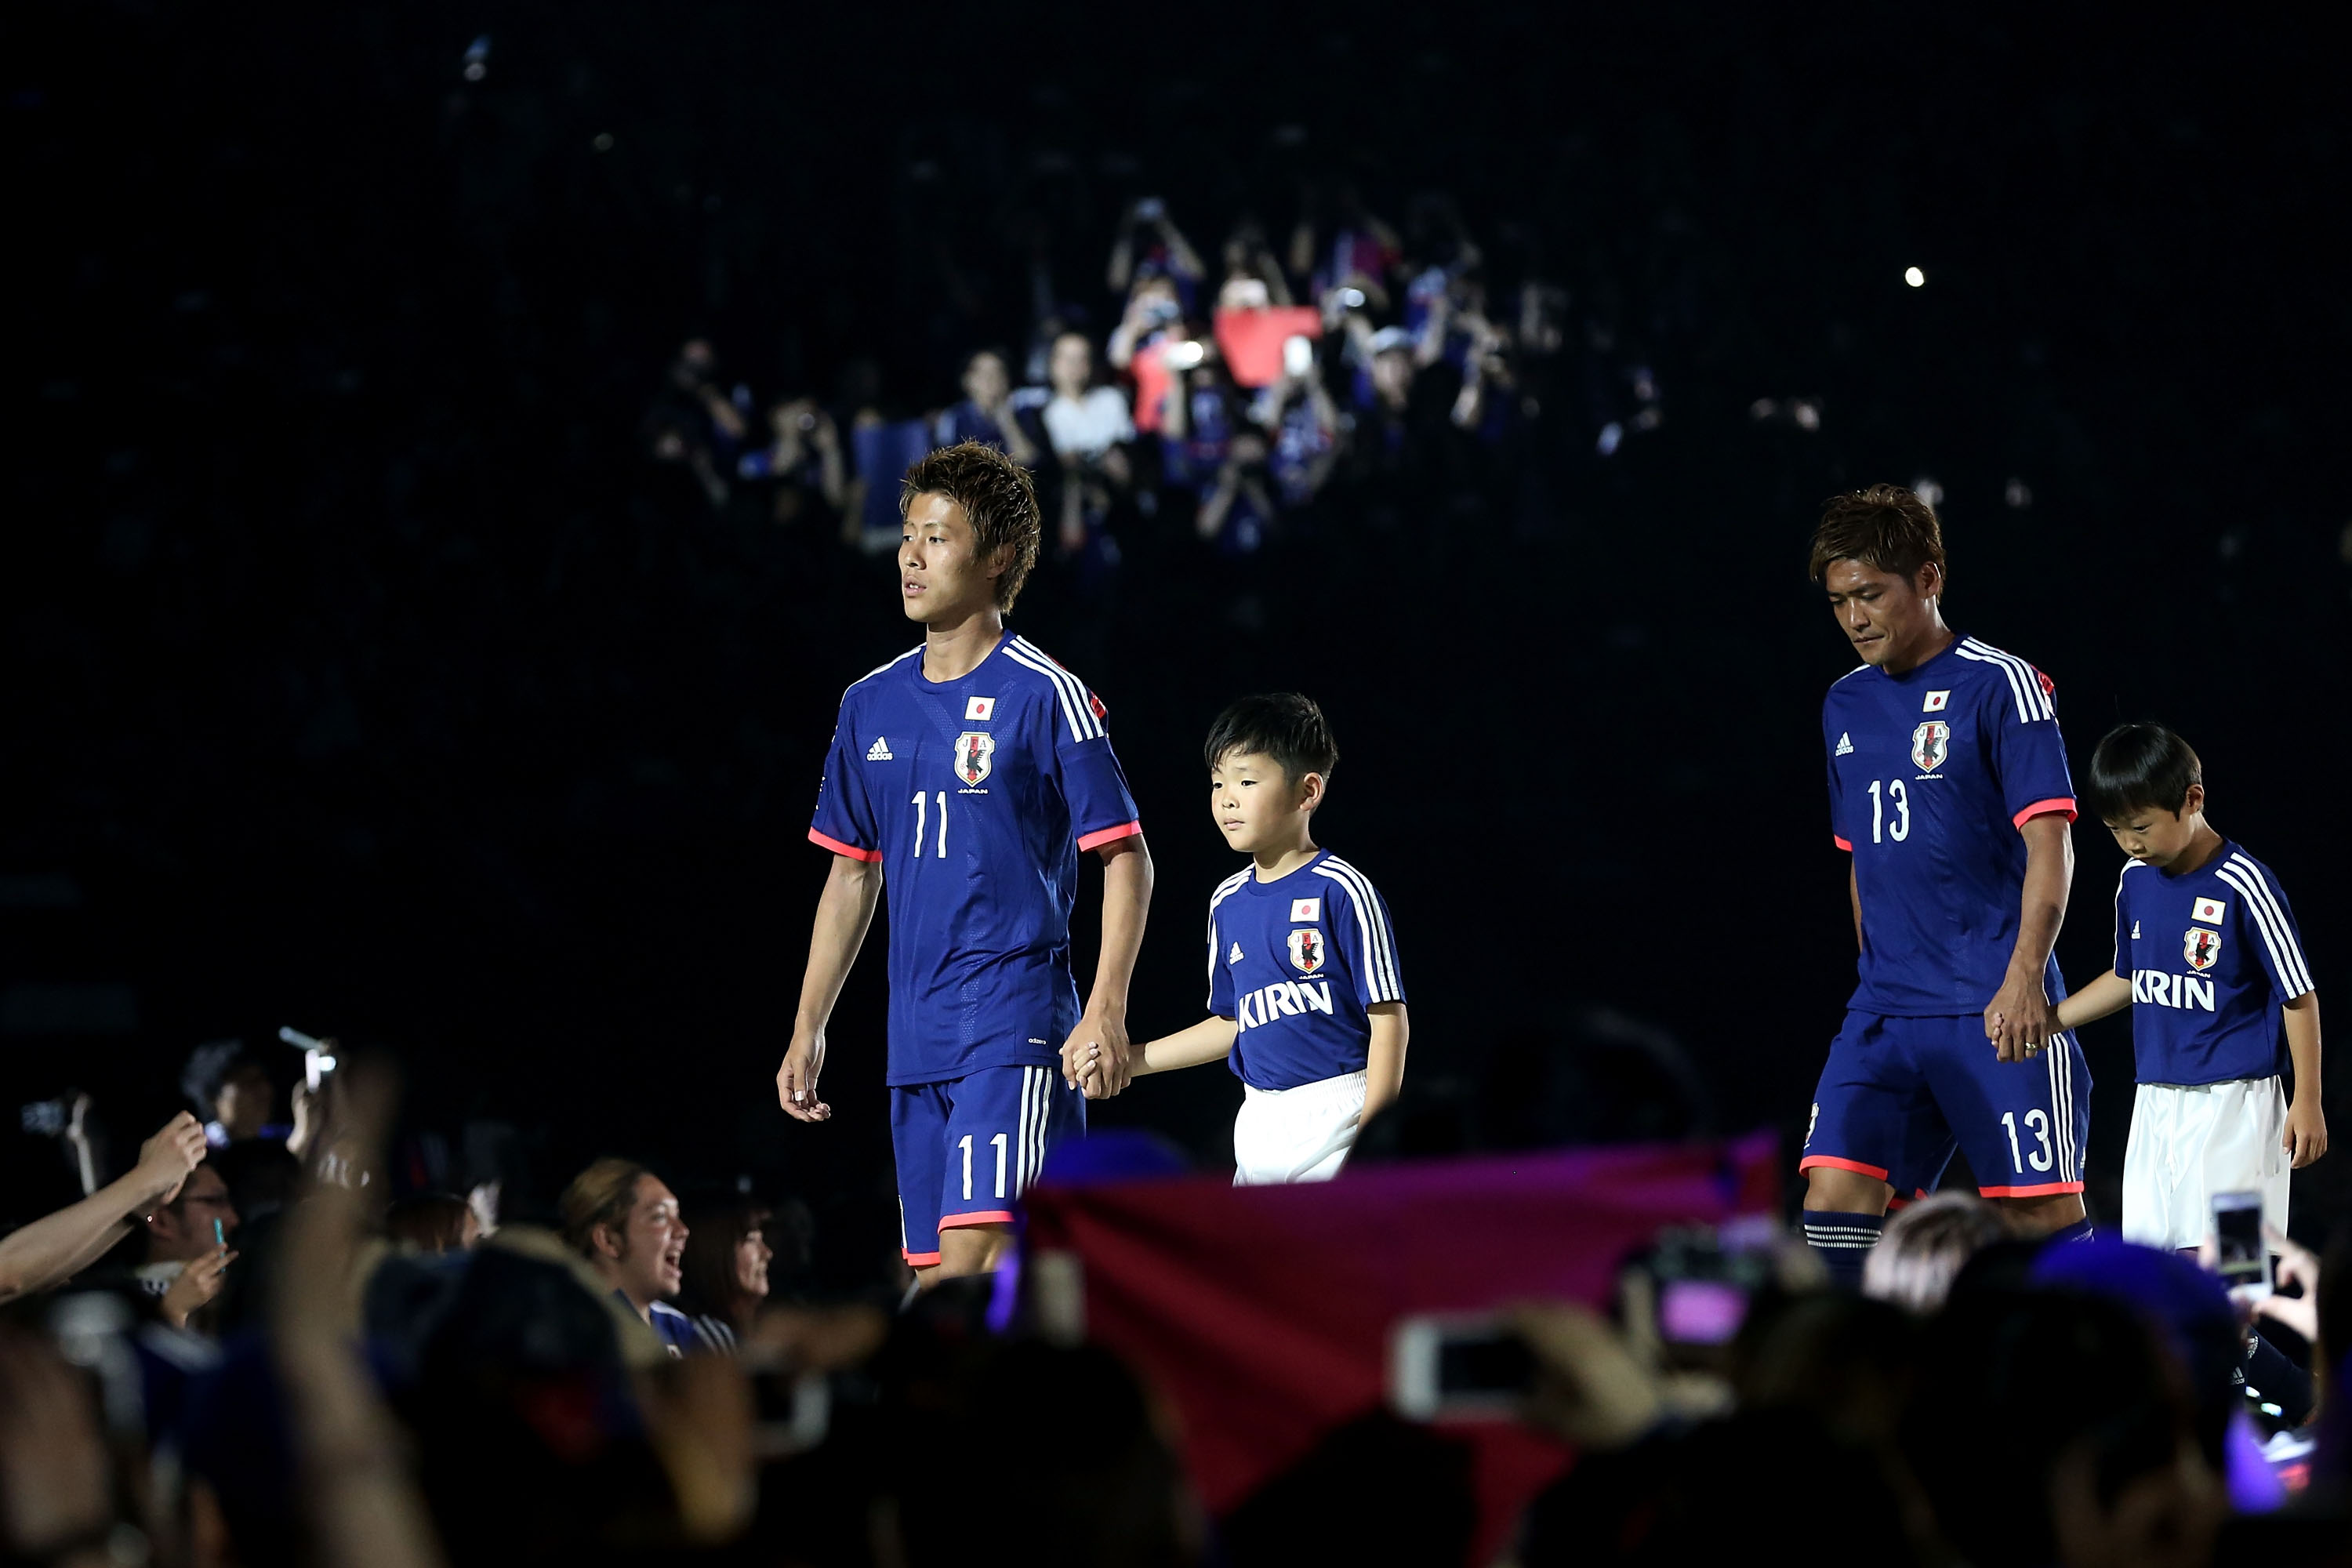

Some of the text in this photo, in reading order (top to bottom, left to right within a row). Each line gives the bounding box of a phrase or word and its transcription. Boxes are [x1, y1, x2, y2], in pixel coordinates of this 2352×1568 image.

[866, 752, 893, 761] adidas
[963, 739, 987, 748] JFA
[911, 790, 947, 858] 11
[1867, 779, 1911, 844] 13
[1239, 980, 1334, 1033] KIRIN
[958, 1133, 1007, 1200] 11
[2001, 1109, 2053, 1174] 13
